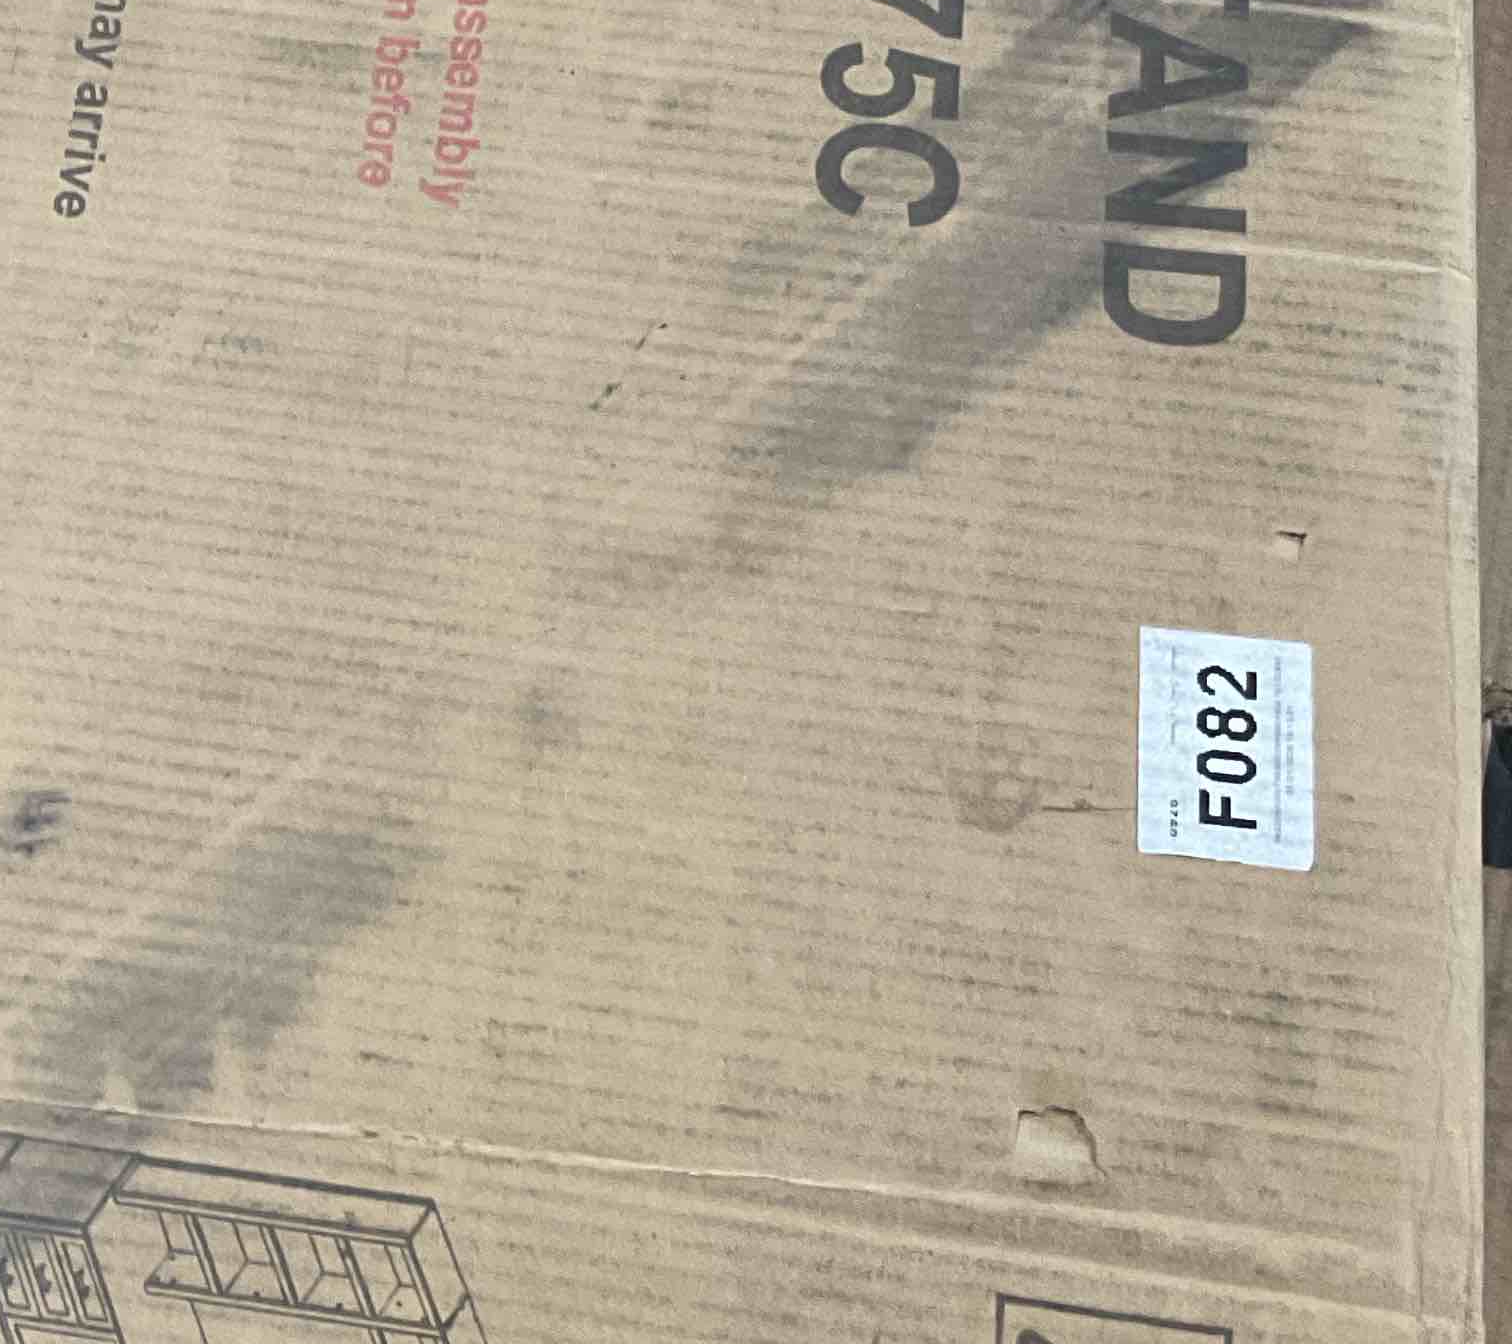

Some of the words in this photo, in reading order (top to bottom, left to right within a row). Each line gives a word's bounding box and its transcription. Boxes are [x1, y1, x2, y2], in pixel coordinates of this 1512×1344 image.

[53, 81, 108, 218] arrive
[358, 36, 421, 188] before
[1196, 665, 1257, 830] F082
